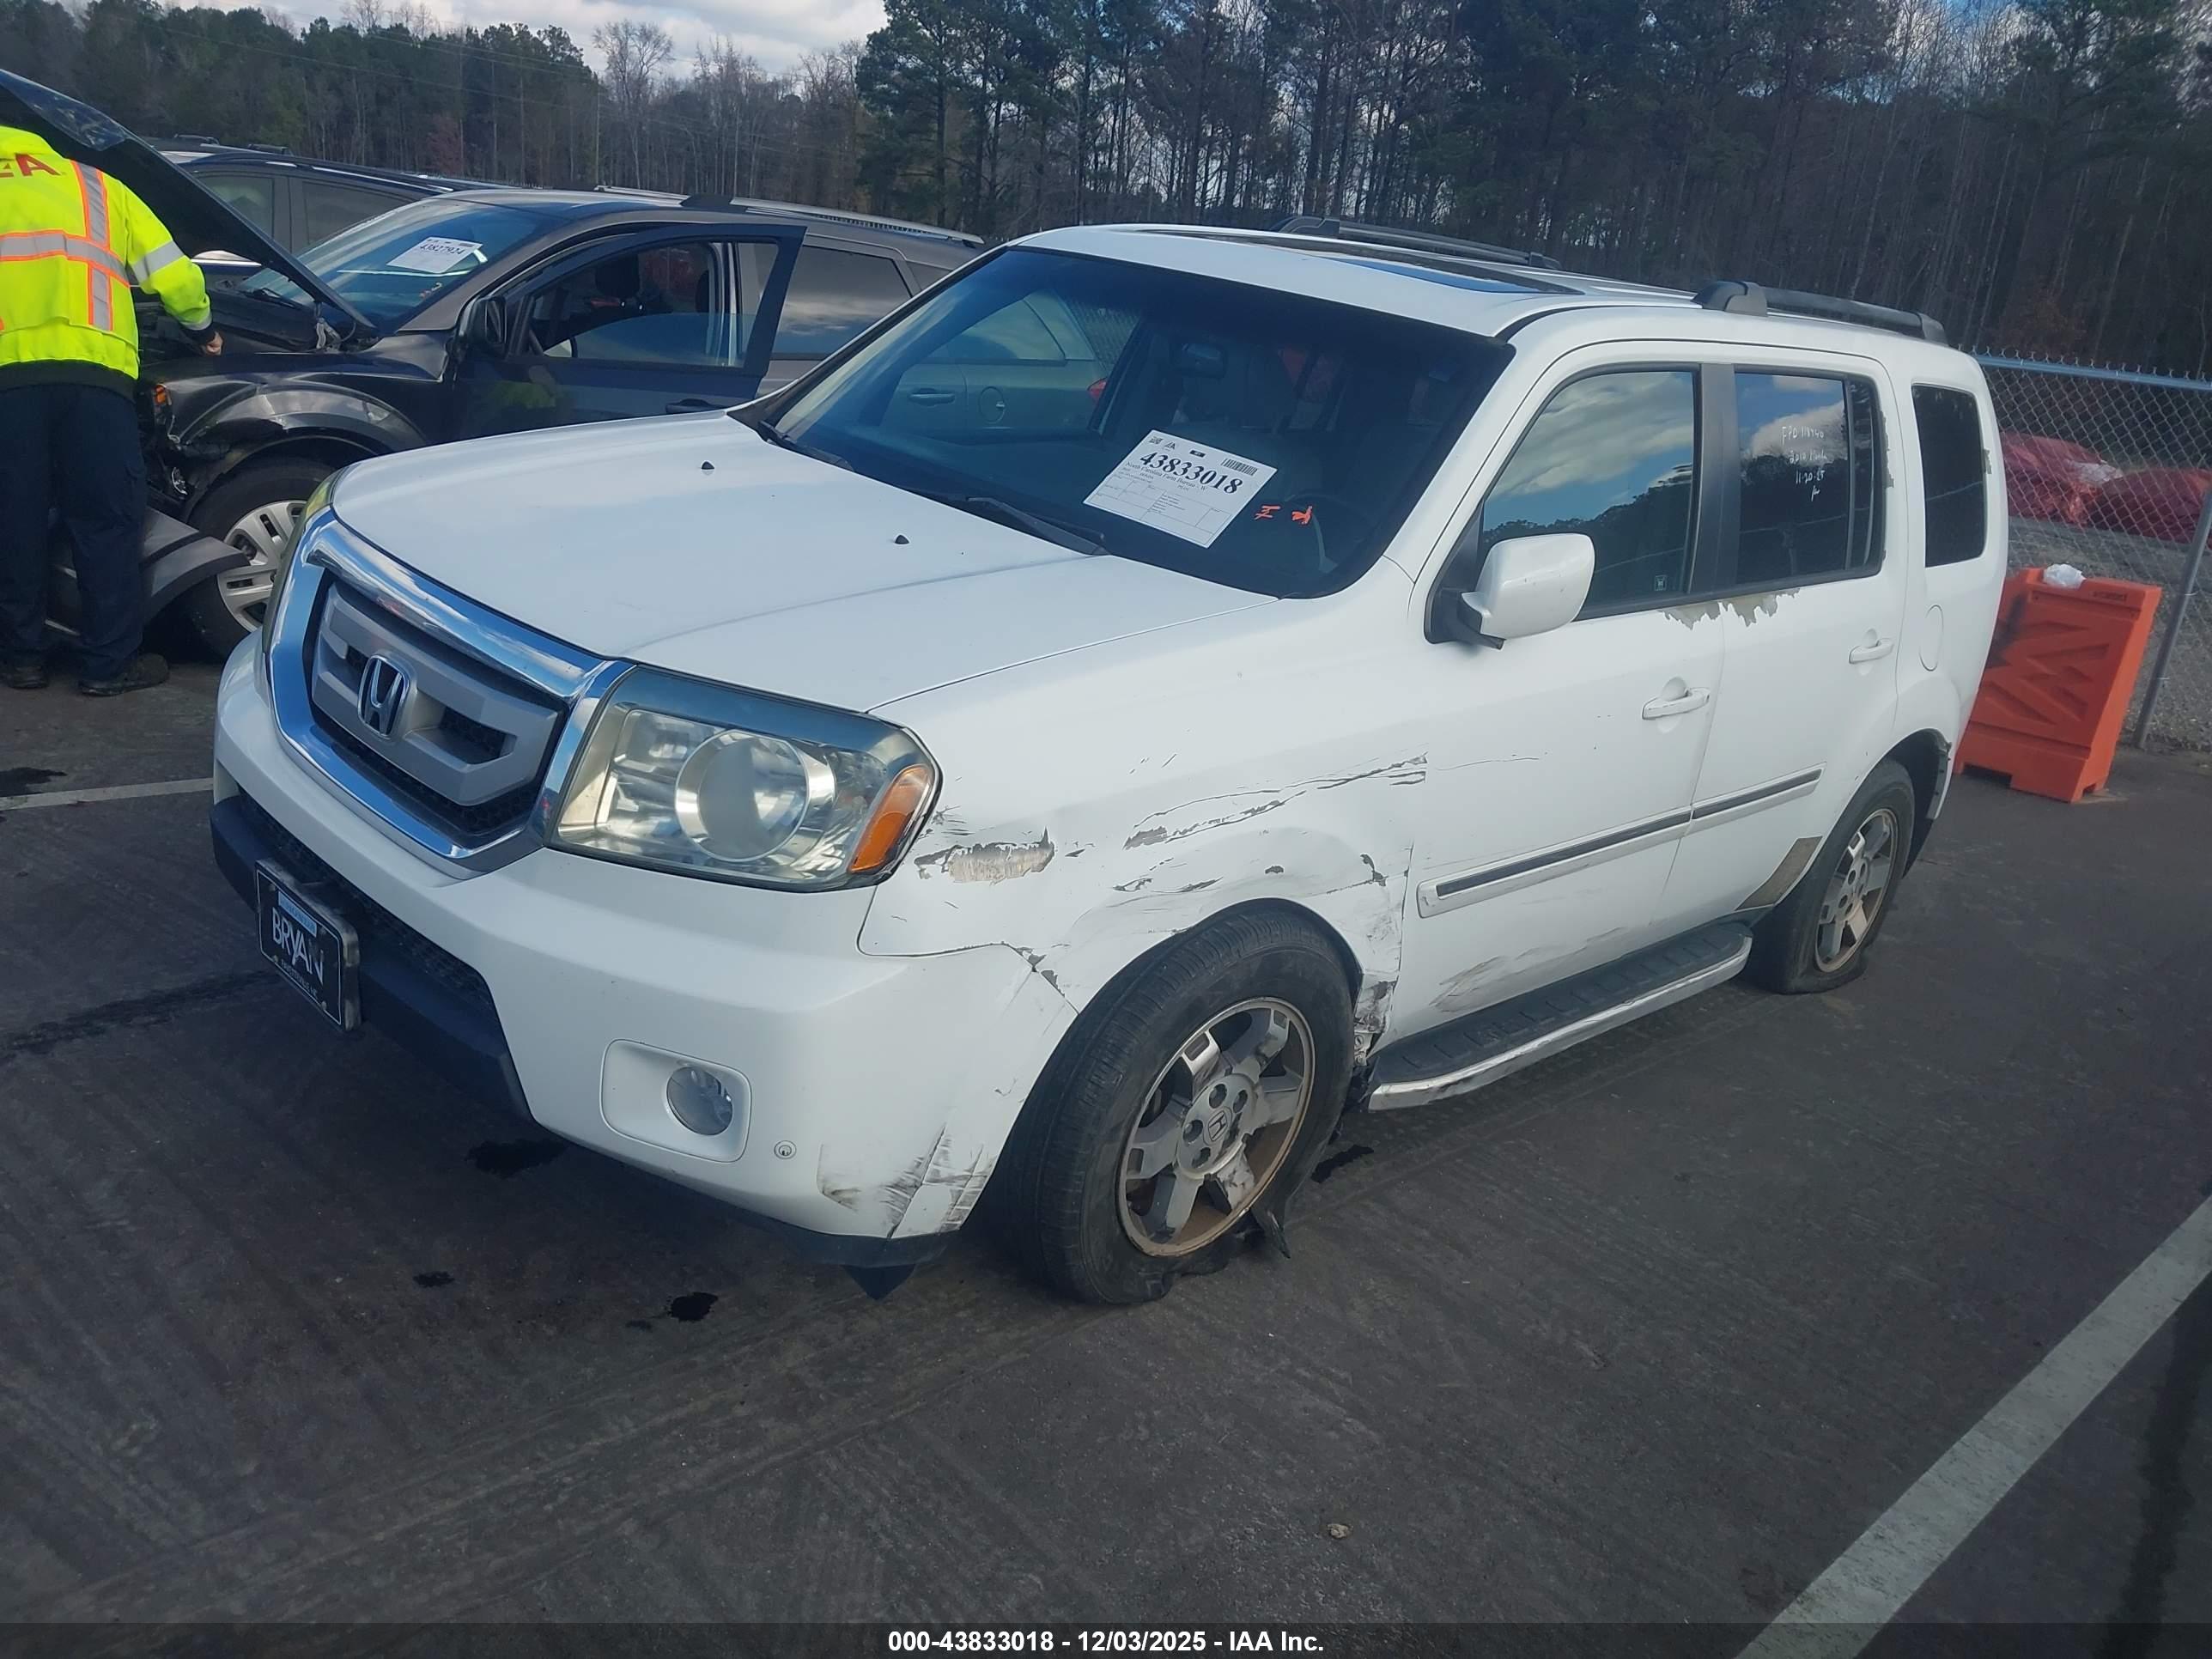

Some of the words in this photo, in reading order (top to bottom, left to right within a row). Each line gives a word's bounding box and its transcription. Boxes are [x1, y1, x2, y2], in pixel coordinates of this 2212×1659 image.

[1126, 461, 1141, 470] North
[1141, 465, 1162, 477] Carolina
[1162, 473, 1176, 482] Farm
[1140, 452, 1243, 494] 43833018
[272, 907, 323, 985] BRYAN
